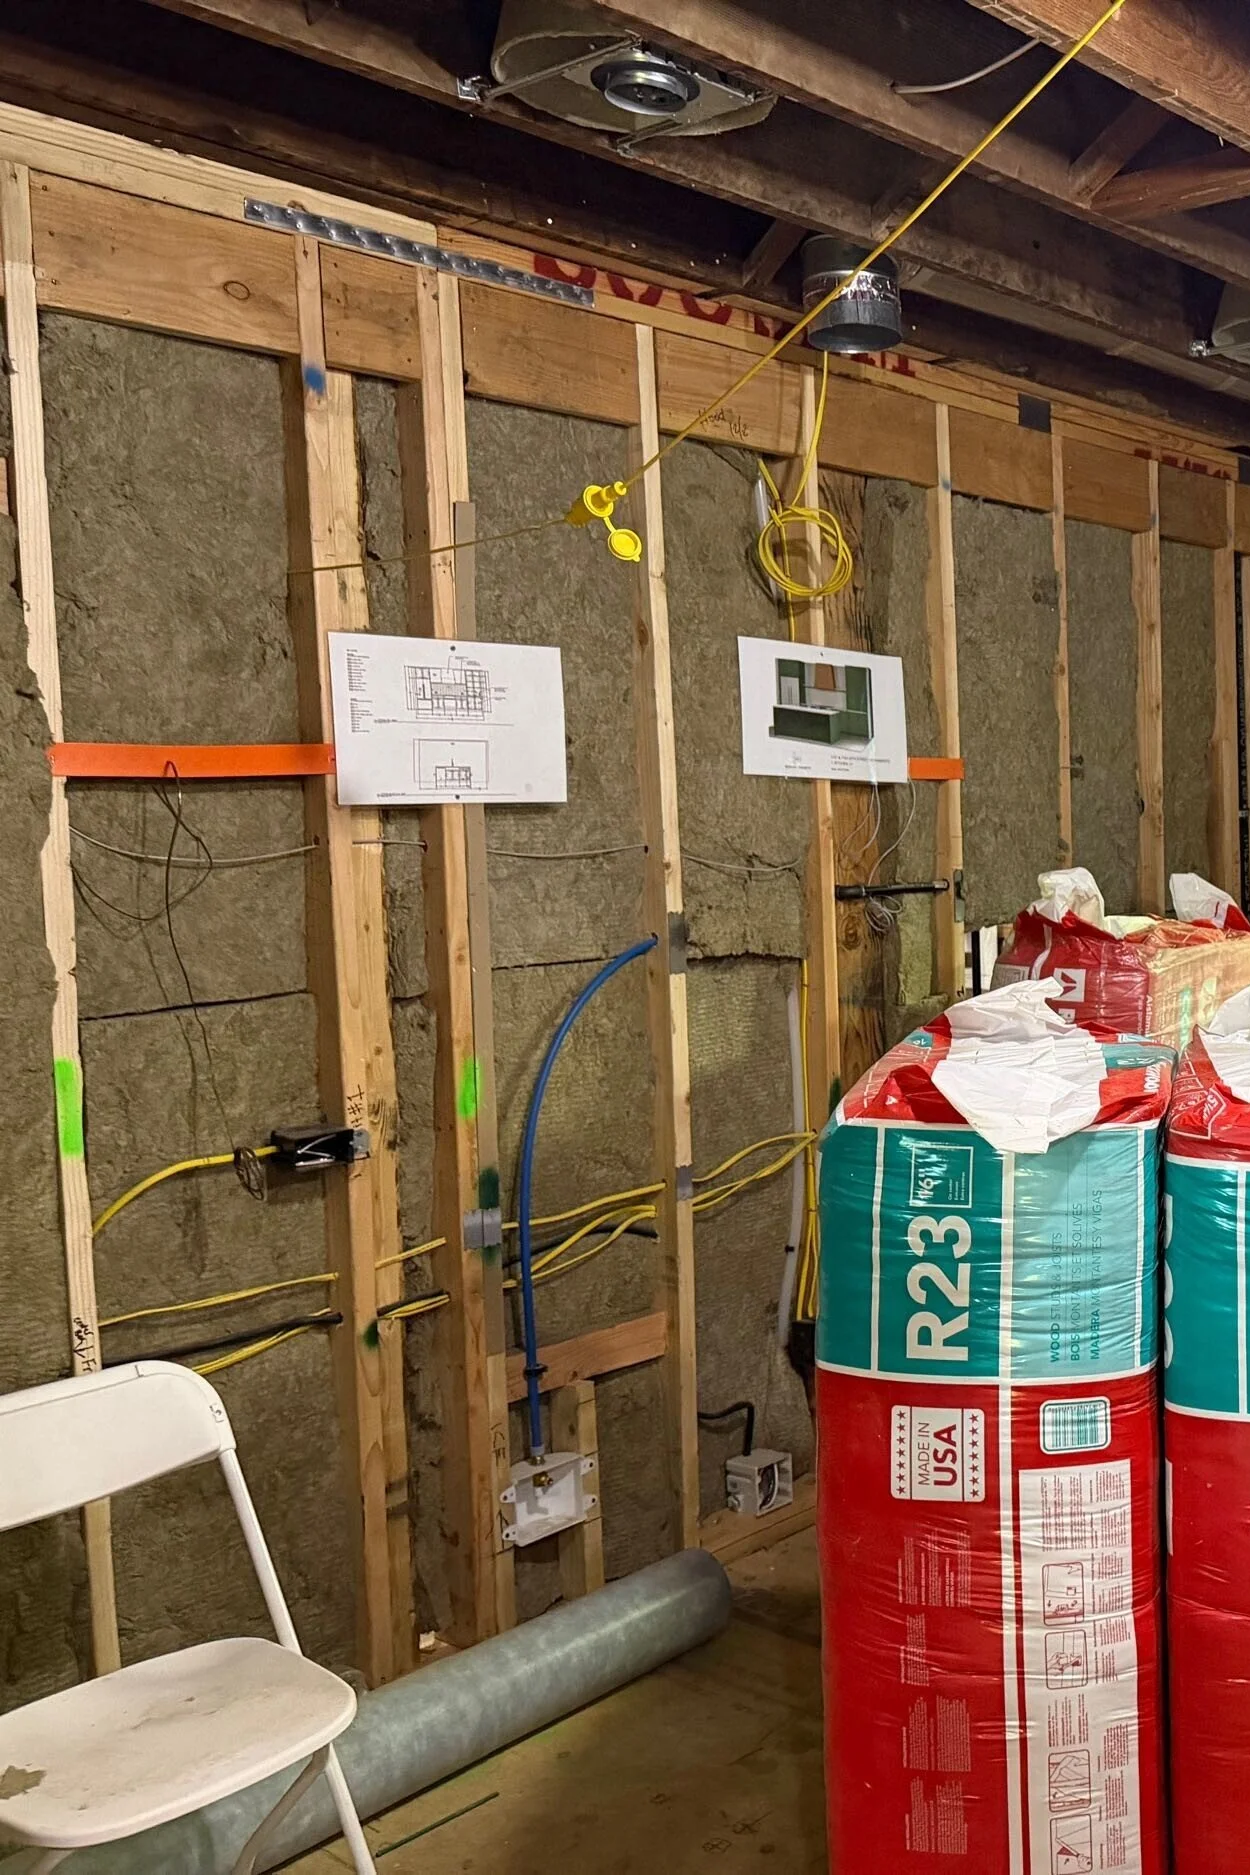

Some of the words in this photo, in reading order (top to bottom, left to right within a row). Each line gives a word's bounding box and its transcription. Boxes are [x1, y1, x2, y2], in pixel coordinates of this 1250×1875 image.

[1071, 1203, 1082, 1248] SOLIVES
[1091, 1189, 1102, 1223] VIGAS
[1051, 1232, 1062, 1269] JOISTS
[1071, 1252, 1081, 1264] ET
[1091, 1236, 1101, 1306] MONTANTES
[906, 1215, 972, 1362] R23
[1051, 1272, 1062, 1282] &
[1051, 1284, 1062, 1321] STUDS
[1071, 1267, 1081, 1332] MONTANTS
[1050, 1323, 1061, 1363] WOOD
[1070, 1333, 1081, 1361] BOIS
[1090, 1309, 1100, 1360] MADERA
[491, 1422, 506, 1468] ICE
[918, 1422, 930, 1438] IN
[918, 1442, 930, 1486] MADE
[933, 1424, 958, 1487] USA
